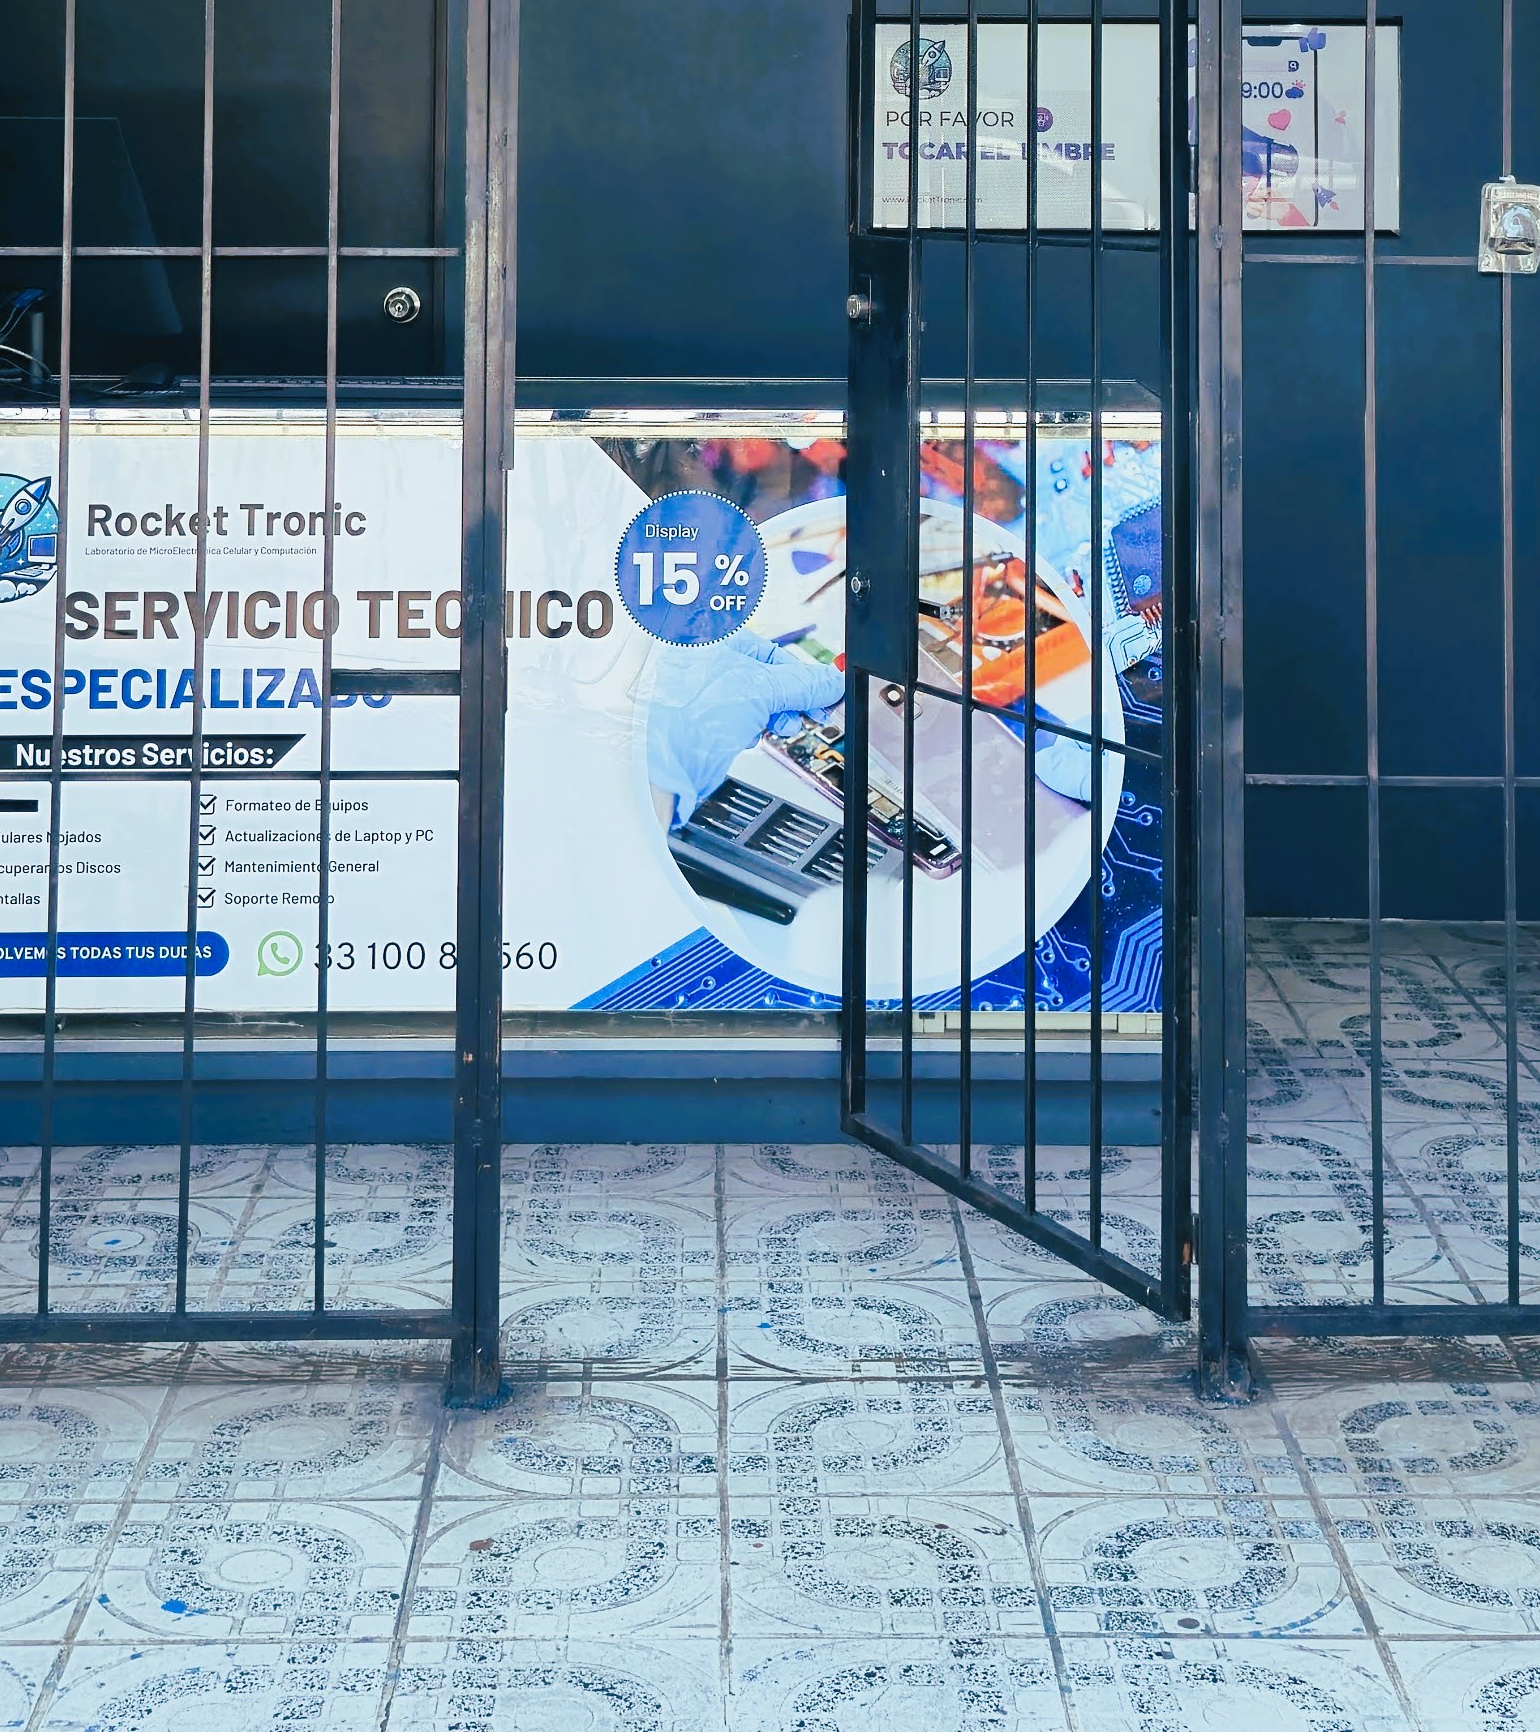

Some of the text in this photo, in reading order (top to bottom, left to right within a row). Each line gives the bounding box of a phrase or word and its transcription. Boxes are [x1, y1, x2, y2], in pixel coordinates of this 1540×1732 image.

[1241, 81, 1283, 99] 9:00
[885, 111, 932, 127] POR
[882, 142, 1116, 161] TOCAR EL MBRE
[87, 502, 367, 537] Rocket Tronic
[645, 524, 700, 541] Display
[85, 546, 317, 558] Laboratorio de MicroElectrnica Celular y Computación
[631, 551, 750, 607] 15 %
[708, 594, 747, 612] OFF
[64, 590, 614, 640] SERVICIO TECICO
[225, 799, 369, 815] Formateo de Euipos
[224, 829, 434, 845] Actualizacione de Laptop y PC
[76, 861, 121, 874] Discos
[328, 860, 380, 873] General
[224, 892, 335, 908] Soporte Remoo
[72, 946, 122, 960] TODAS
[125, 946, 156, 960] TUS
[367, 941, 427, 970] 100
[438, 941, 458, 970] 8
[501, 941, 559, 970] 560
